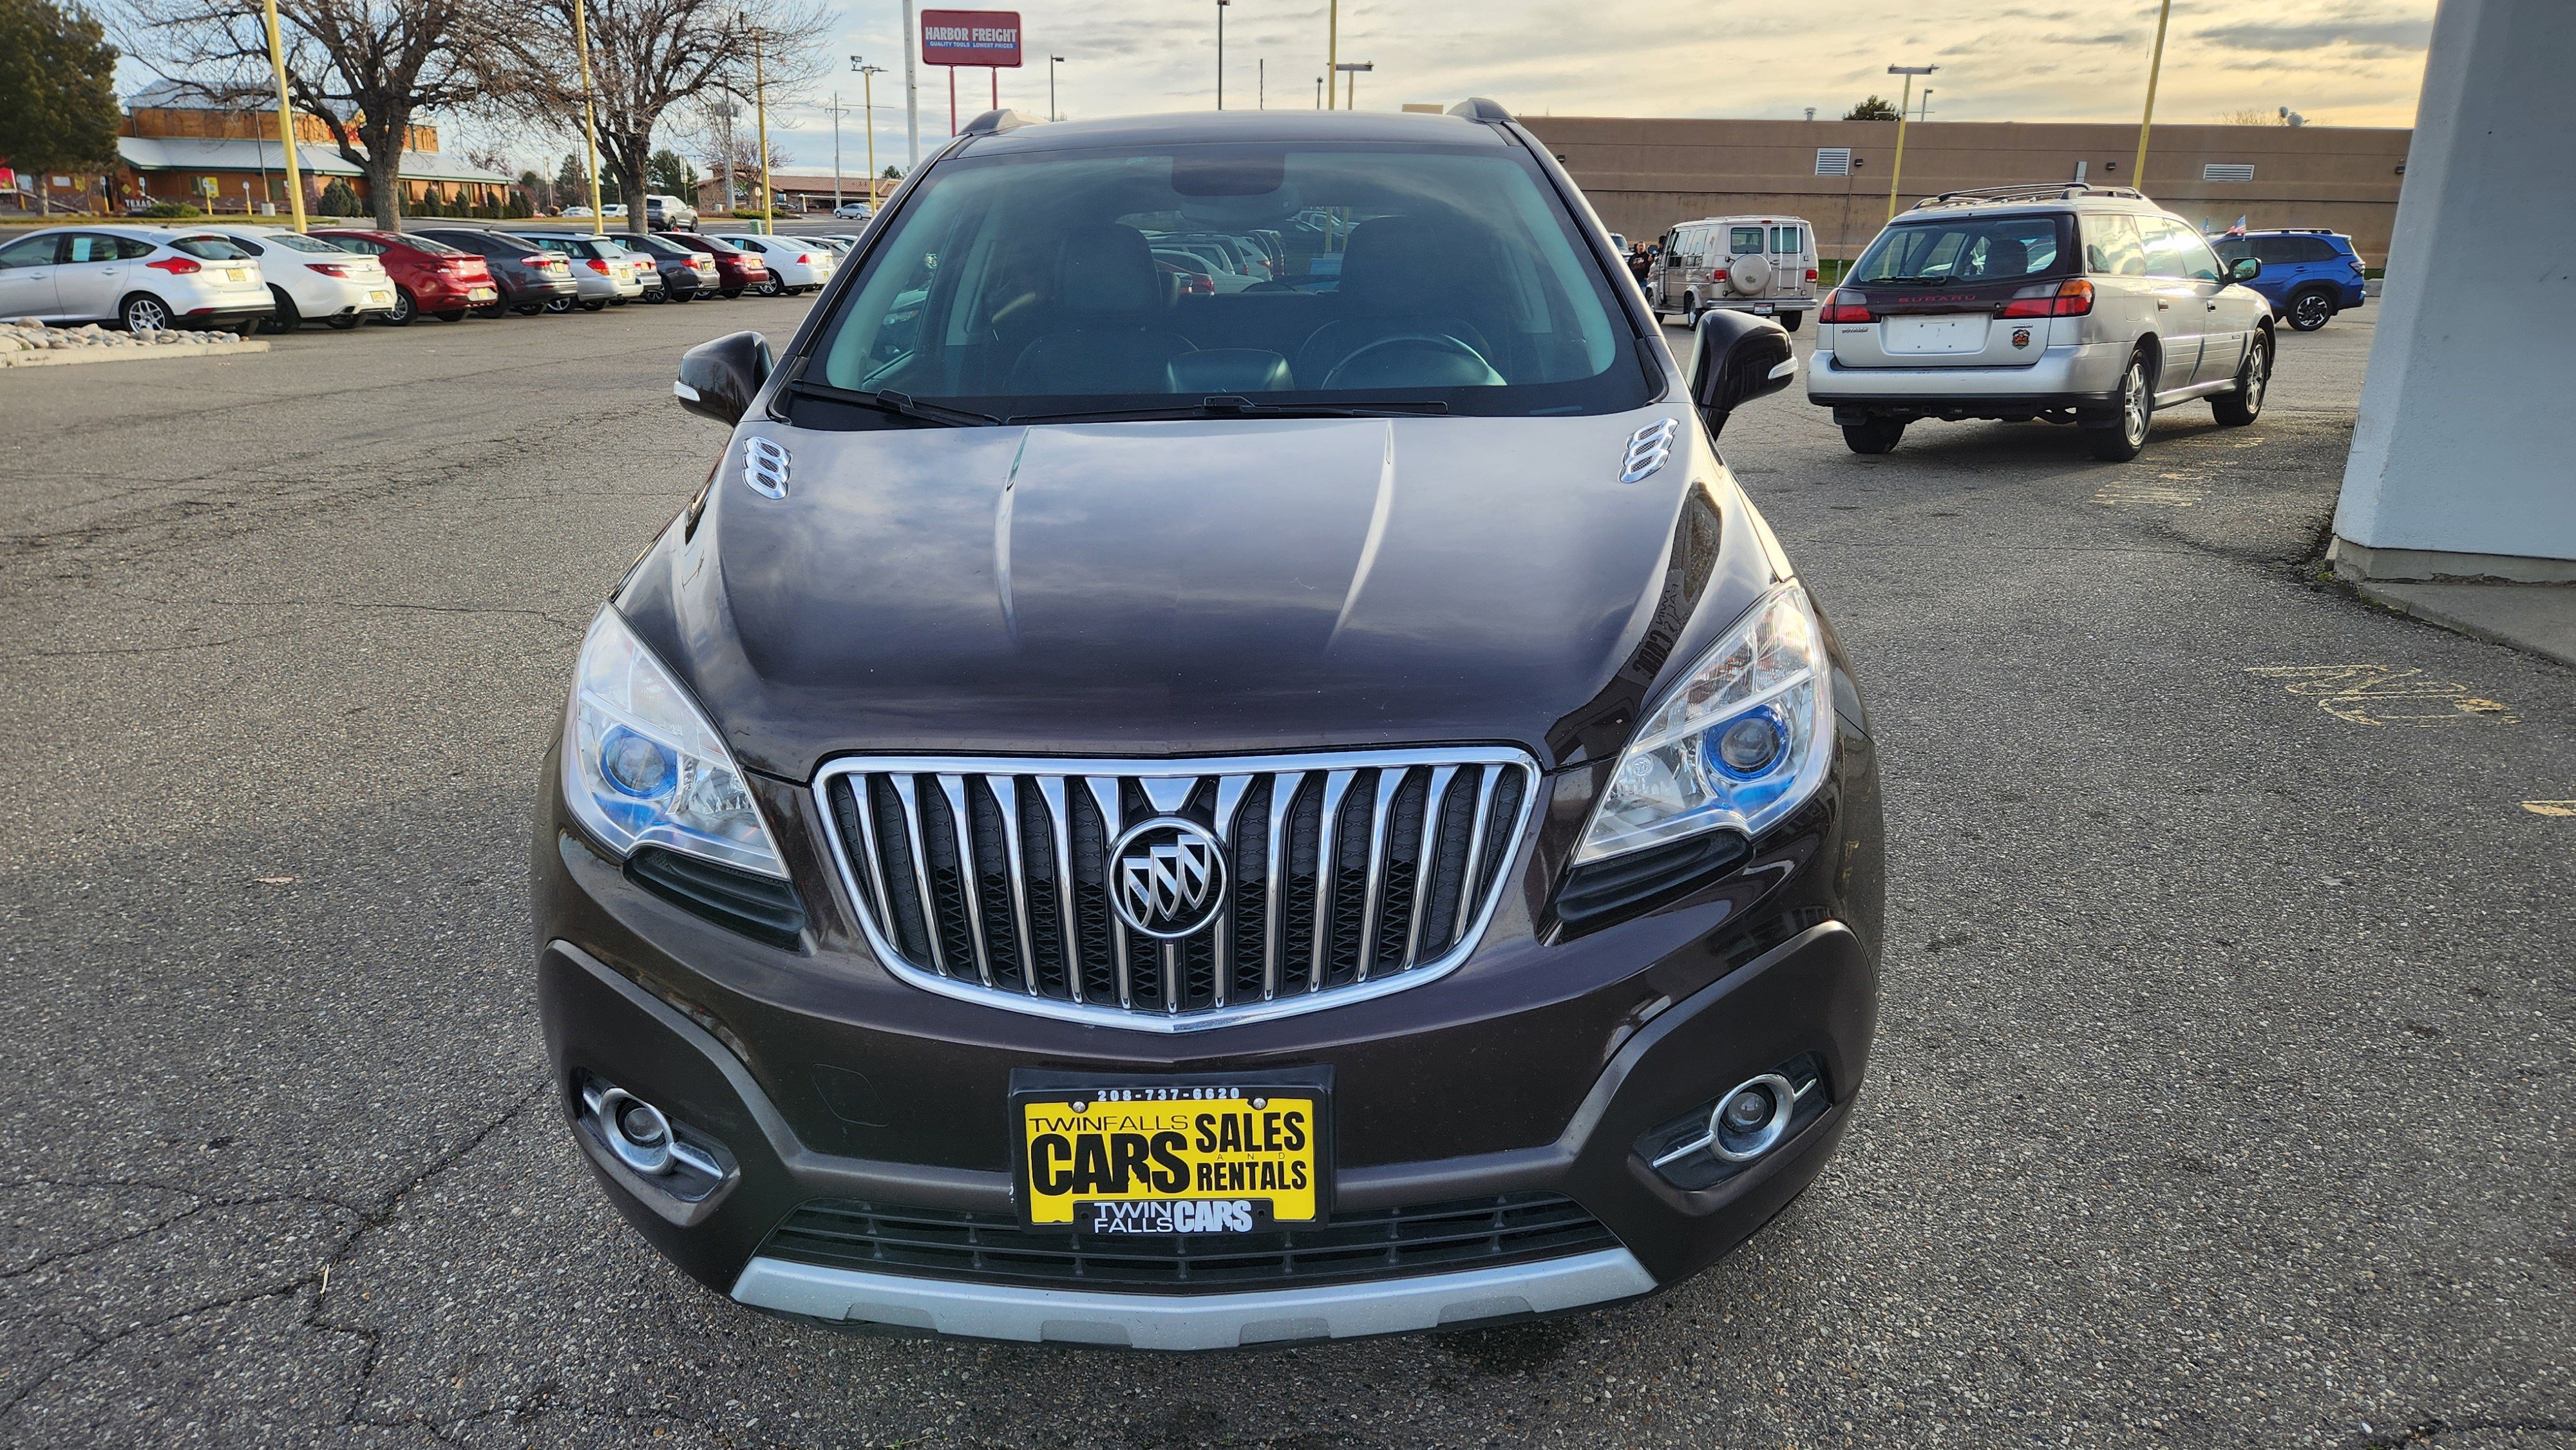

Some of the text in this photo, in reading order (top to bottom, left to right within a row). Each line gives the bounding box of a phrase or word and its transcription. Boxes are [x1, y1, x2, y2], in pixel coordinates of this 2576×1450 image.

[925, 26, 1017, 42] HARBOR FREIGHT
[124, 199, 152, 208] TEXAS
[1097, 1088, 1240, 1102] 208-737-6620
[1195, 1111, 1307, 1154] SALES
[1030, 1131, 1191, 1196] CARS
[1217, 1151, 1285, 1161] AND
[1197, 1160, 1308, 1191] RENTALS
[1094, 1200, 1253, 1233] TWIN CARS
[1094, 1218, 1173, 1234] FALLS
